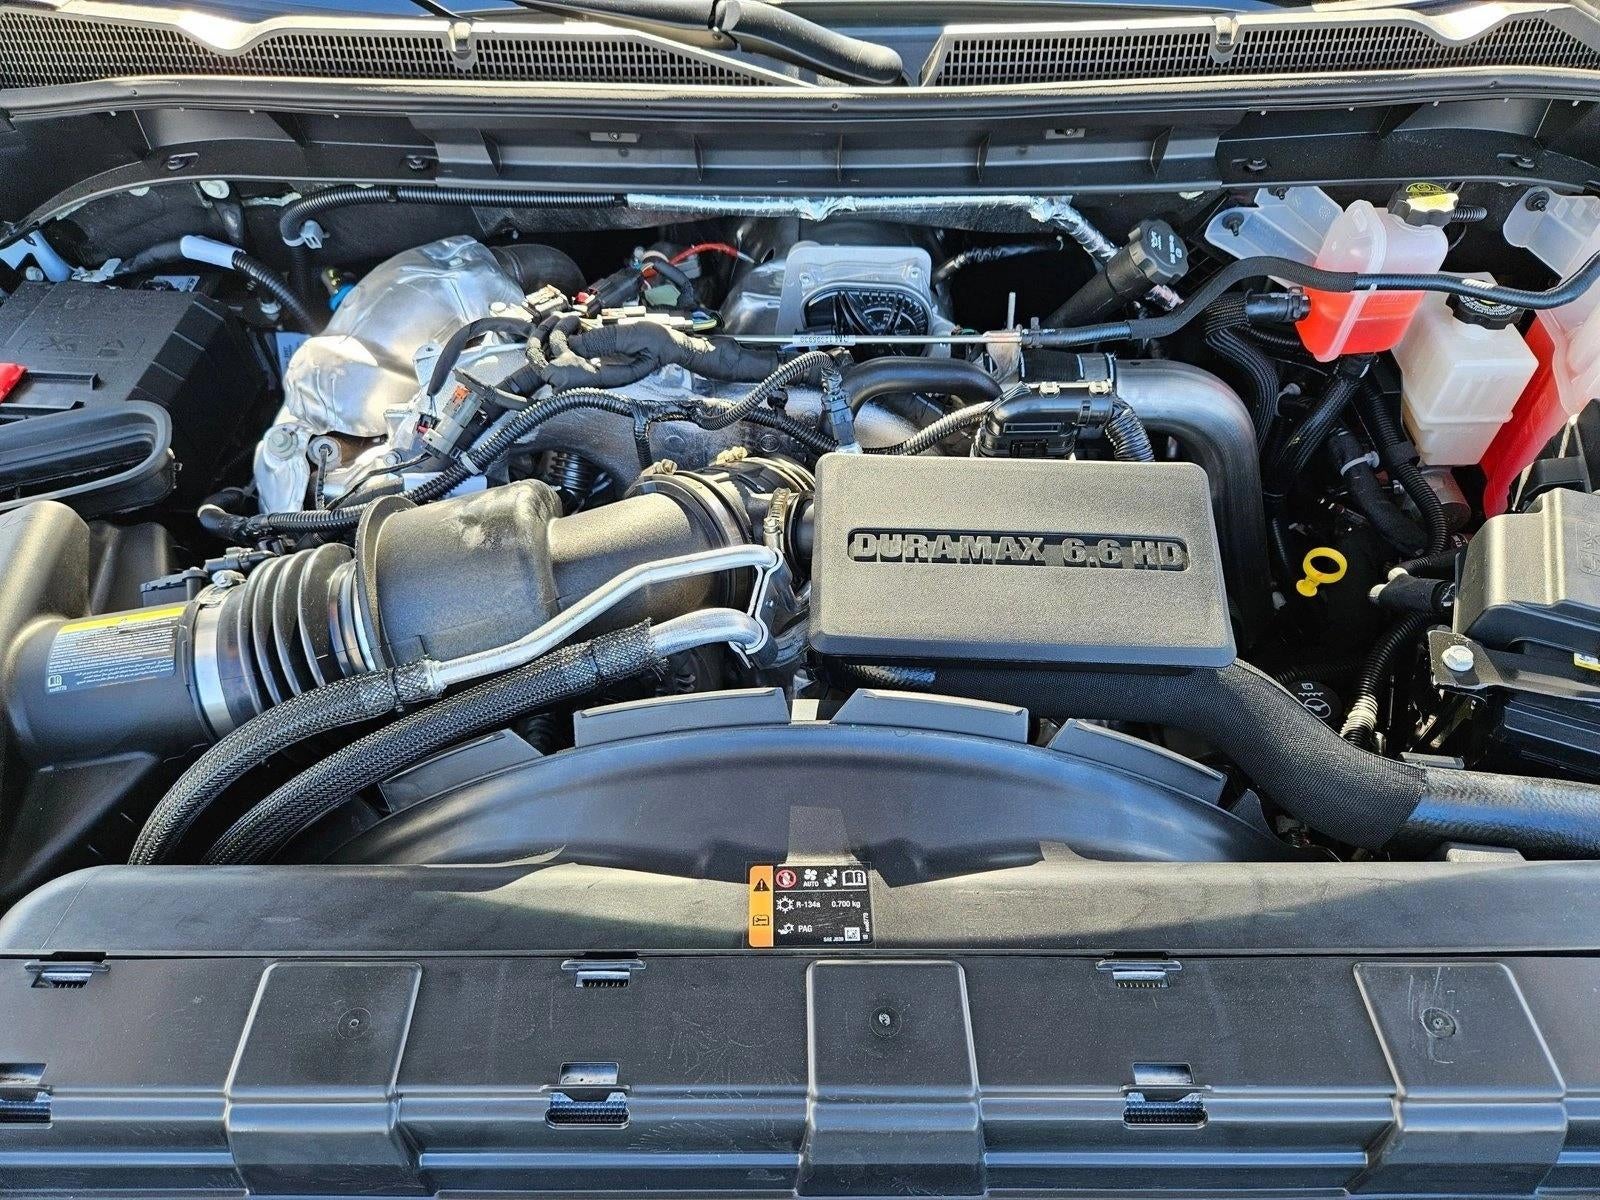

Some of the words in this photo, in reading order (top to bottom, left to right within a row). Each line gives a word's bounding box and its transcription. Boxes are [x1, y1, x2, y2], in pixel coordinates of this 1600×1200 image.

[853, 532, 1045, 563] DURAMAX
[1061, 537, 1123, 565] 6.6
[1132, 540, 1186, 568] HD
[852, 900, 861, 909] kg
[798, 925, 812, 933] PAG
